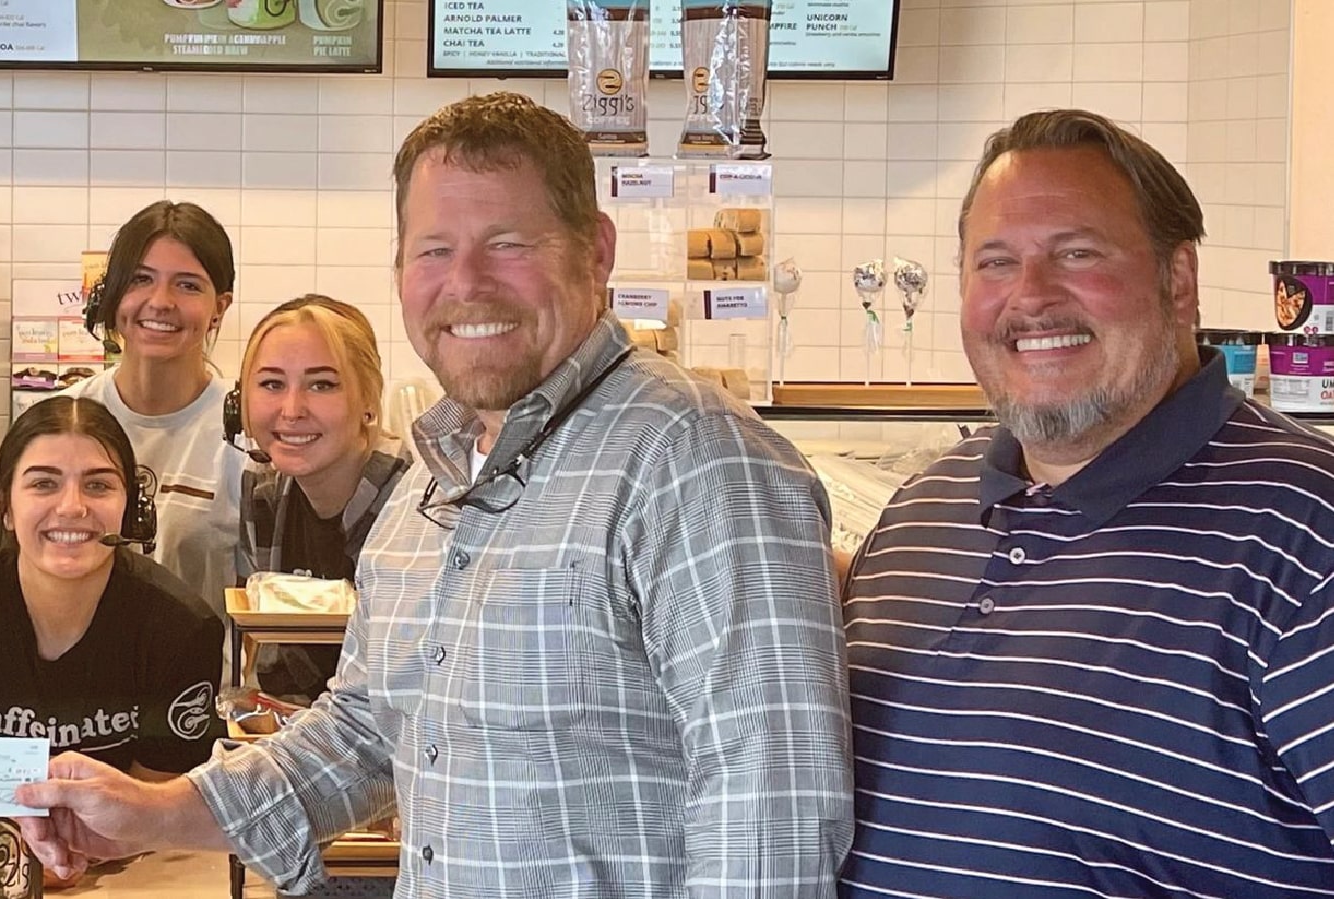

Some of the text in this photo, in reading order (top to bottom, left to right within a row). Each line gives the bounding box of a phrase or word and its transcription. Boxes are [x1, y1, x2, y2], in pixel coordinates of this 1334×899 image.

[444, 14, 522, 23] ARNOLD PALMER
[444, 27, 532, 35] MATCHA TEA LATTE
[582, 94, 634, 116] Ziggi's
